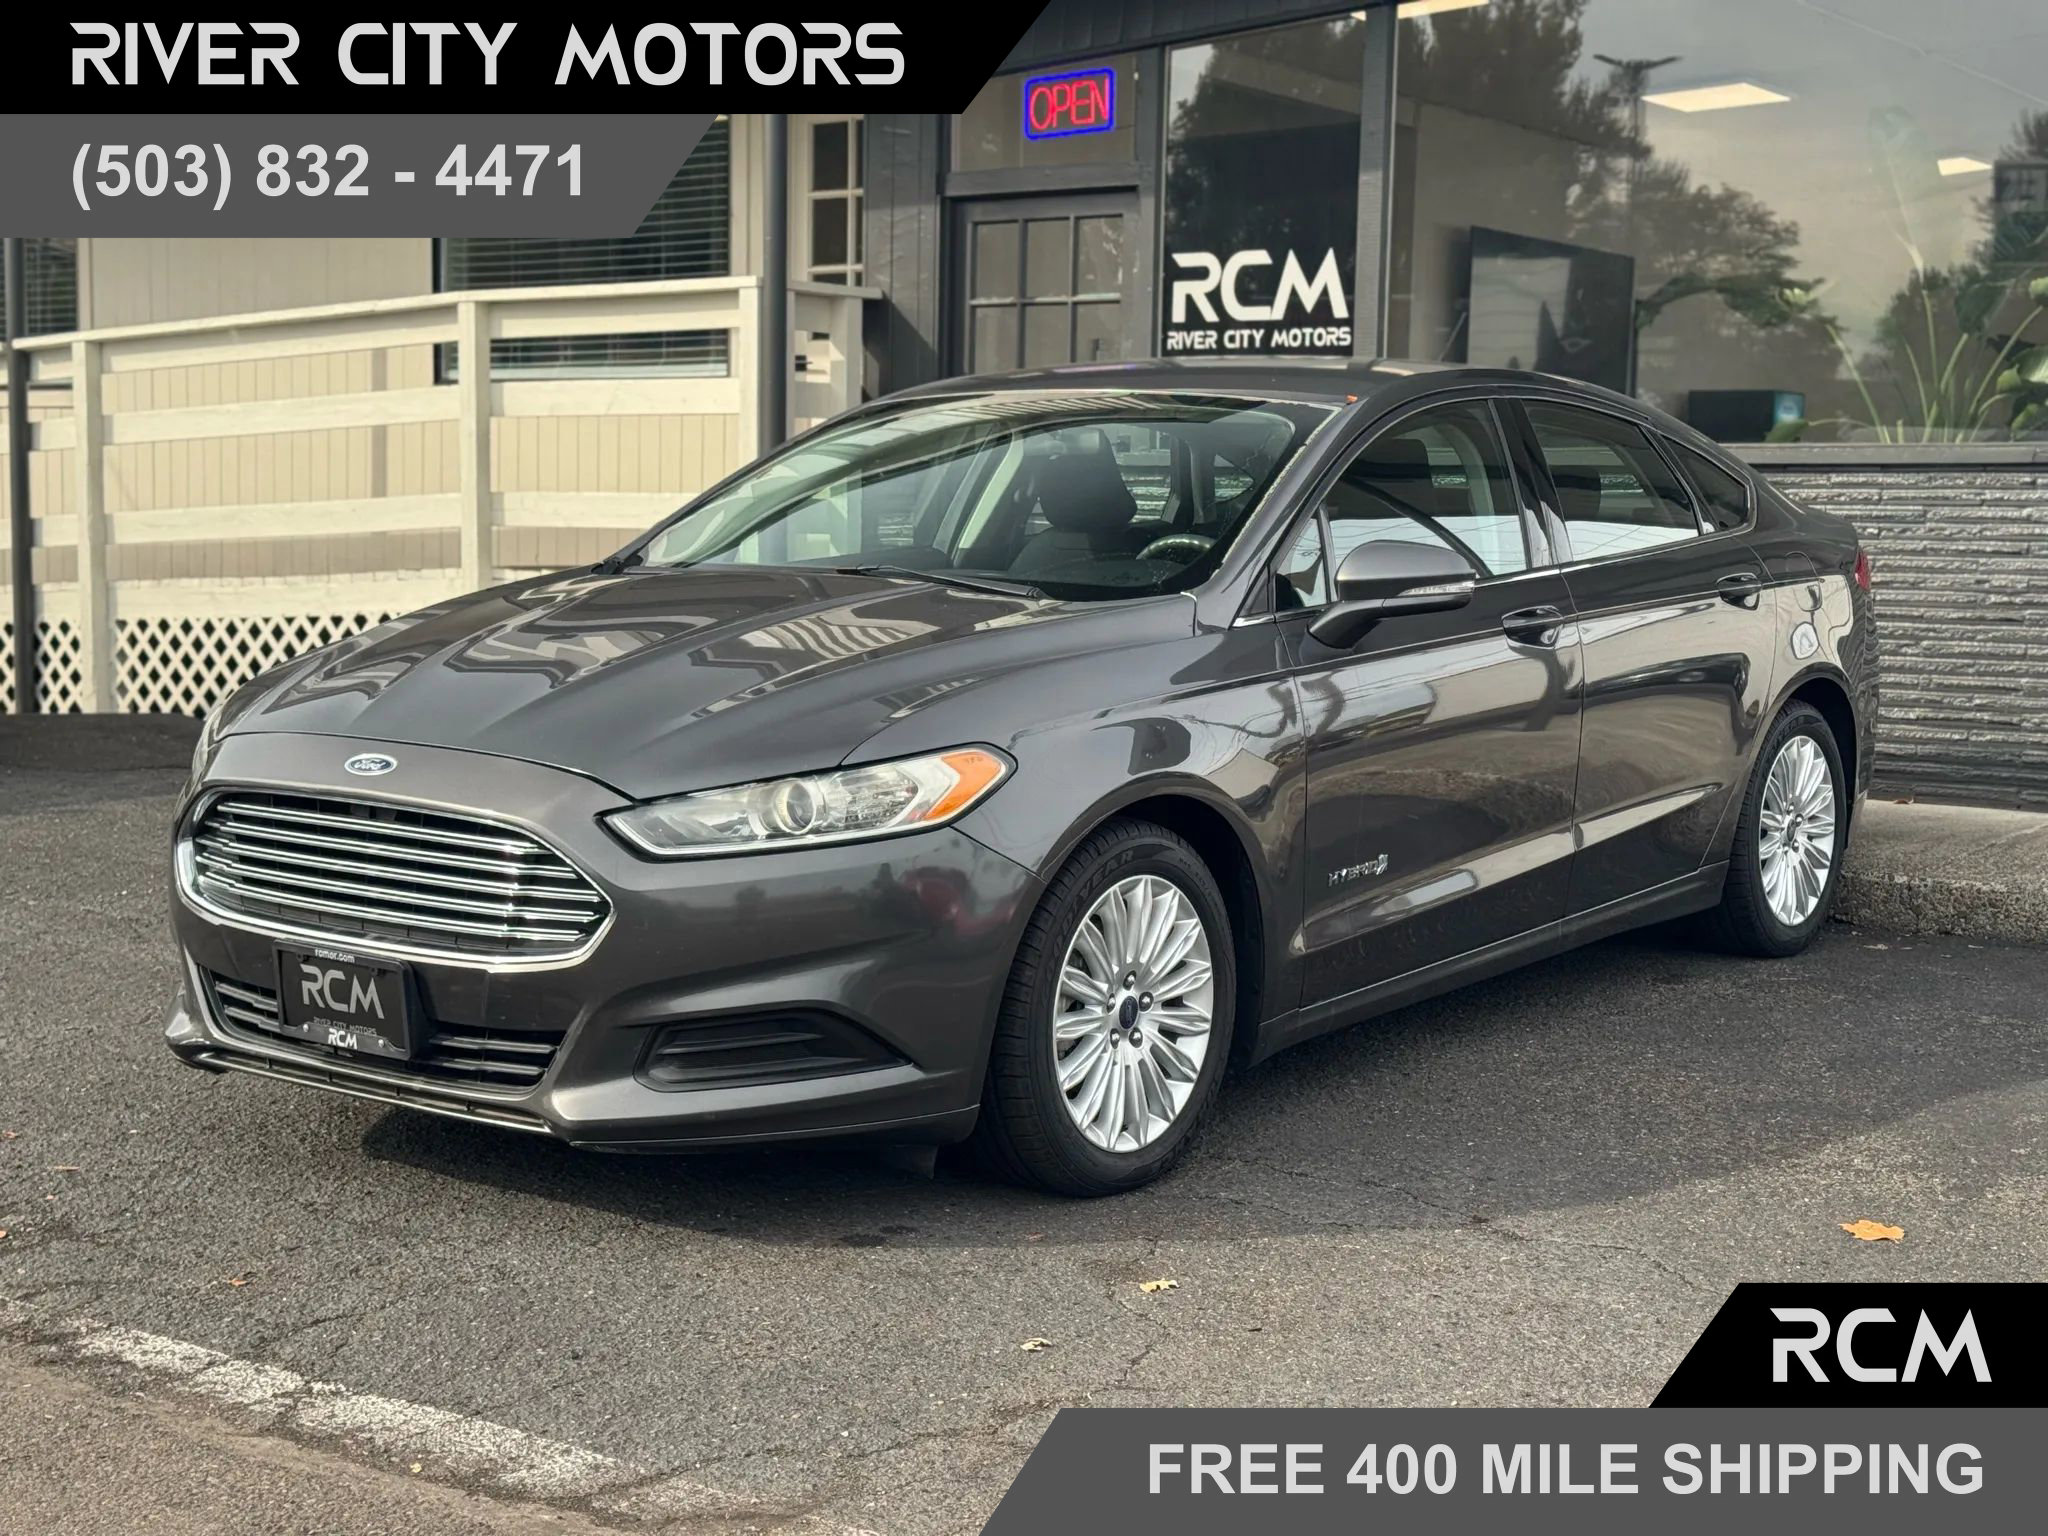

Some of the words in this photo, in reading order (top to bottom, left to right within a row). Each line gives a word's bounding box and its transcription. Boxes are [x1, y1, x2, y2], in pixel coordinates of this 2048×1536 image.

[1030, 74, 1109, 131] OPEN
[1171, 247, 1350, 323] RCM
[1166, 329, 1218, 350] RIVER
[1223, 328, 1265, 349] CITY
[1270, 326, 1352, 348] MOTORS
[1328, 860, 1379, 887] HYBRID
[300, 963, 385, 1020] RCM
[327, 1027, 358, 1050] RCM
